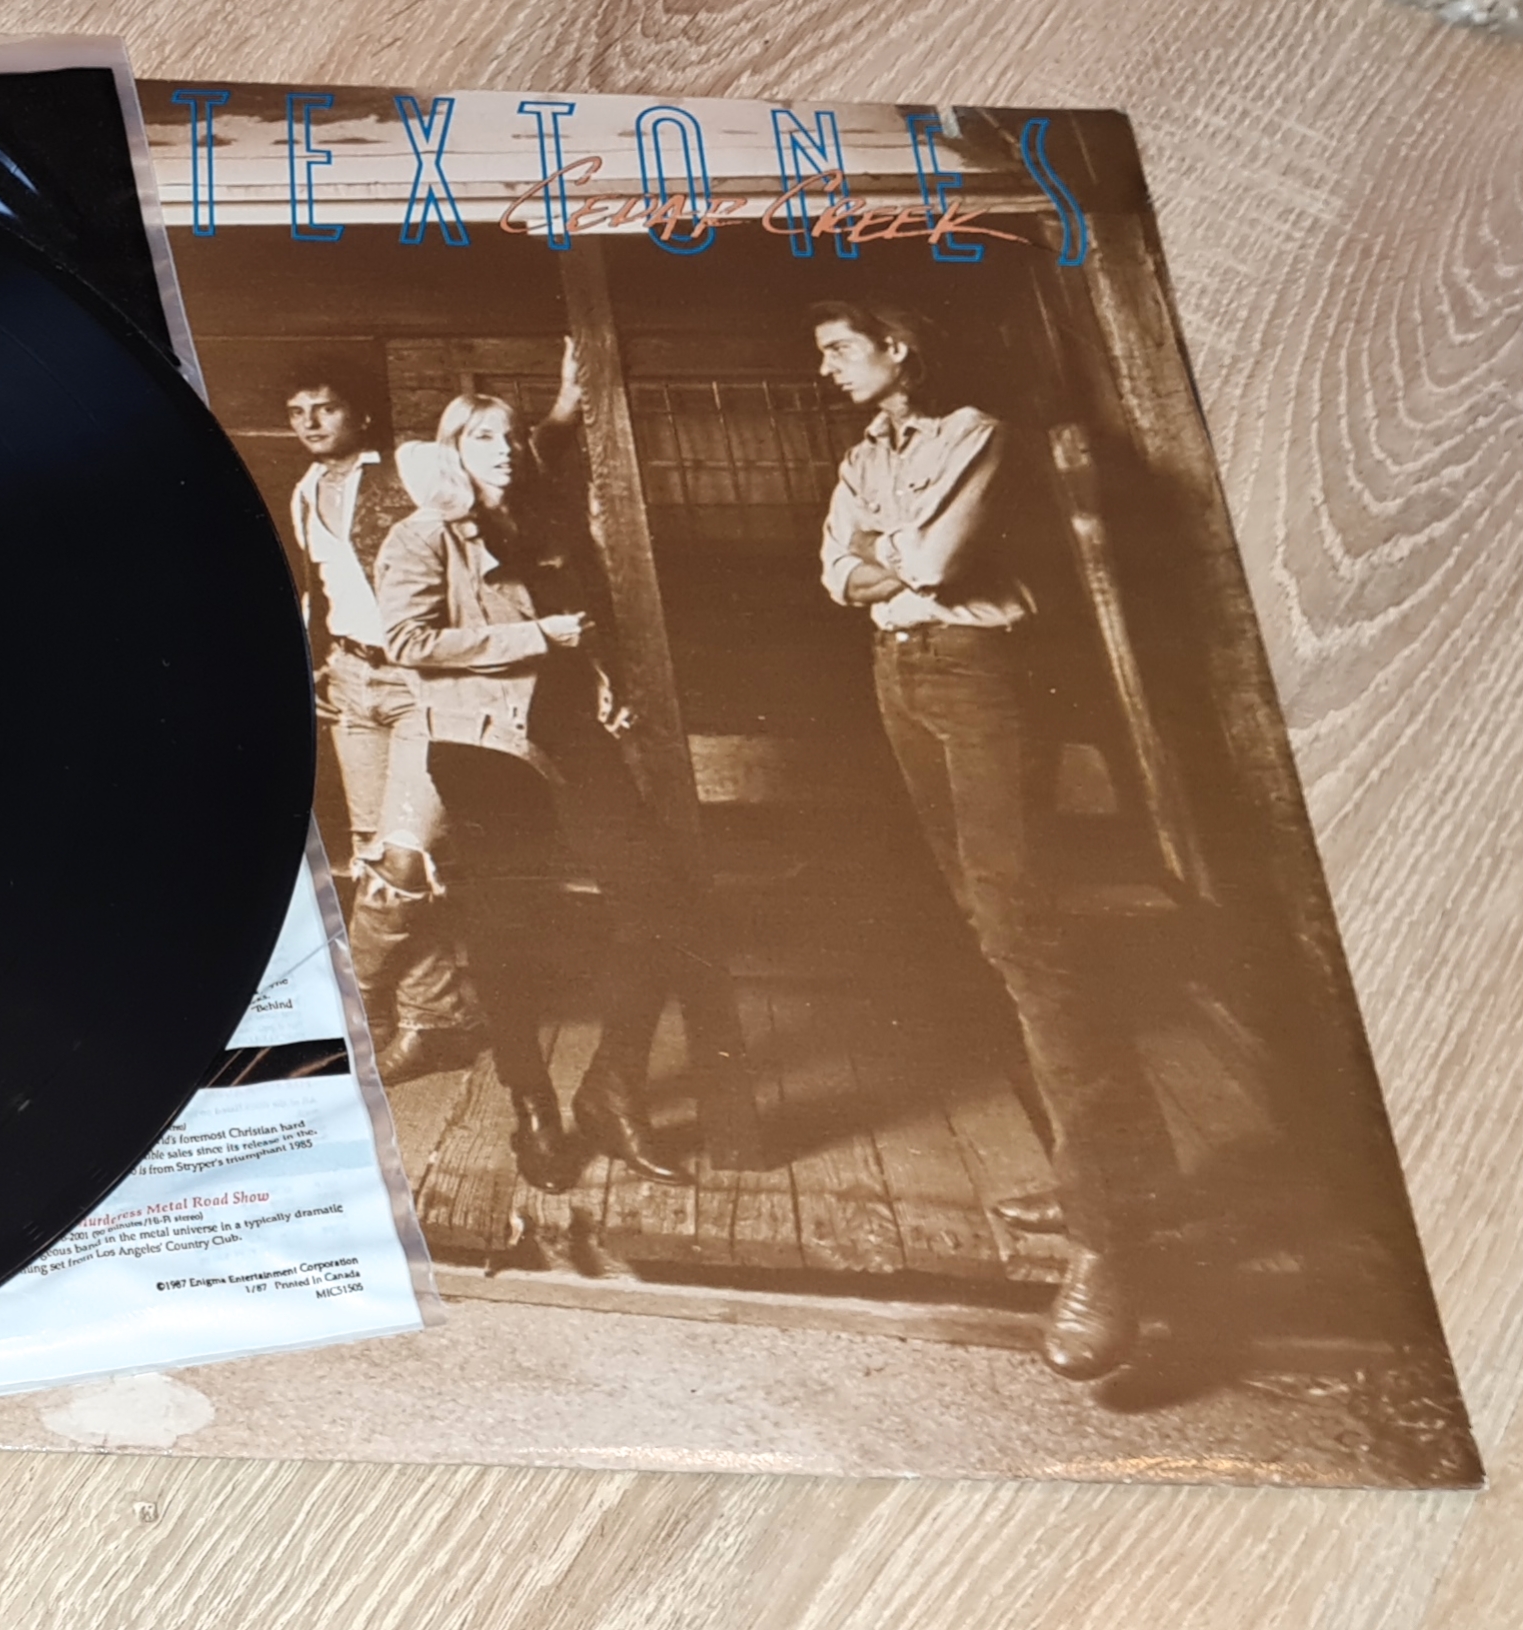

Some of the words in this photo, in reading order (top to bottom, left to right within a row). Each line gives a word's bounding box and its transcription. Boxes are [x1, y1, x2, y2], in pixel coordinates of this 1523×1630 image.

[172, 89, 1088, 267] TEXTONES
[179, 1130, 226, 1144] foremost
[228, 1126, 278, 1138] Christian
[279, 1119, 306, 1133] hard
[146, 1198, 187, 1215] Metal
[192, 1193, 227, 1208] Road
[232, 1191, 269, 1204] Show
[188, 1277, 227, 1287] Enigma
[227, 1267, 297, 1283] Entertainment
[299, 1257, 358, 1272] Corporation
